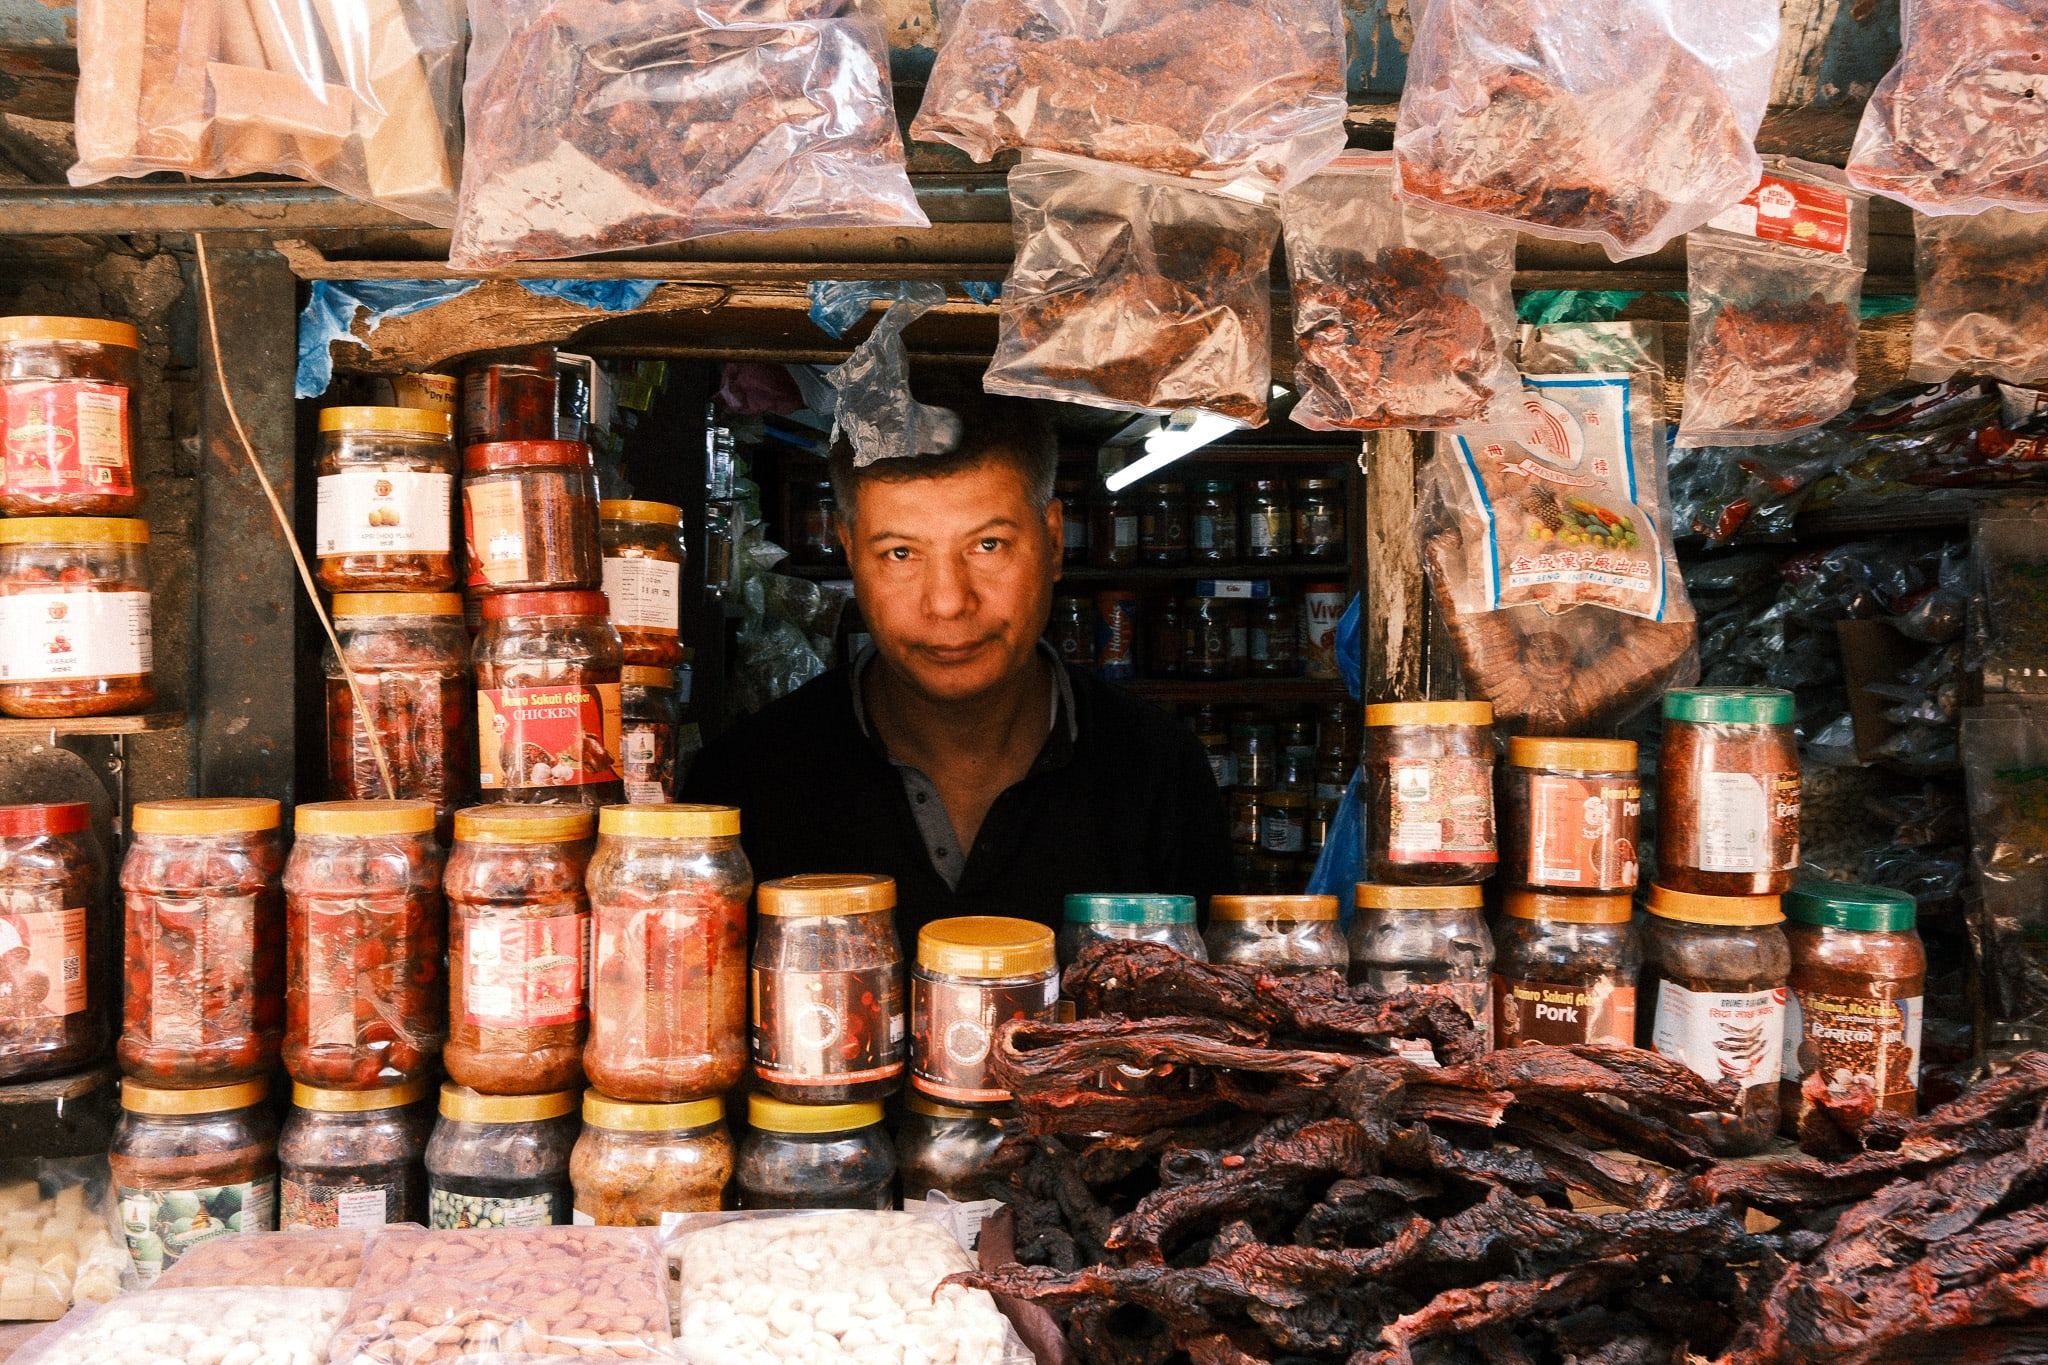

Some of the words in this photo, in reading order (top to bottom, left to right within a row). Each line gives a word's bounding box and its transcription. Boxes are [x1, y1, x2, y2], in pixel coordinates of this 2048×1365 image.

[530, 691, 562, 706] Sakuti
[512, 707, 579, 721] CHICKEN
[1542, 989, 1574, 1005] Sakuti
[1535, 1003, 1579, 1023] Pork
